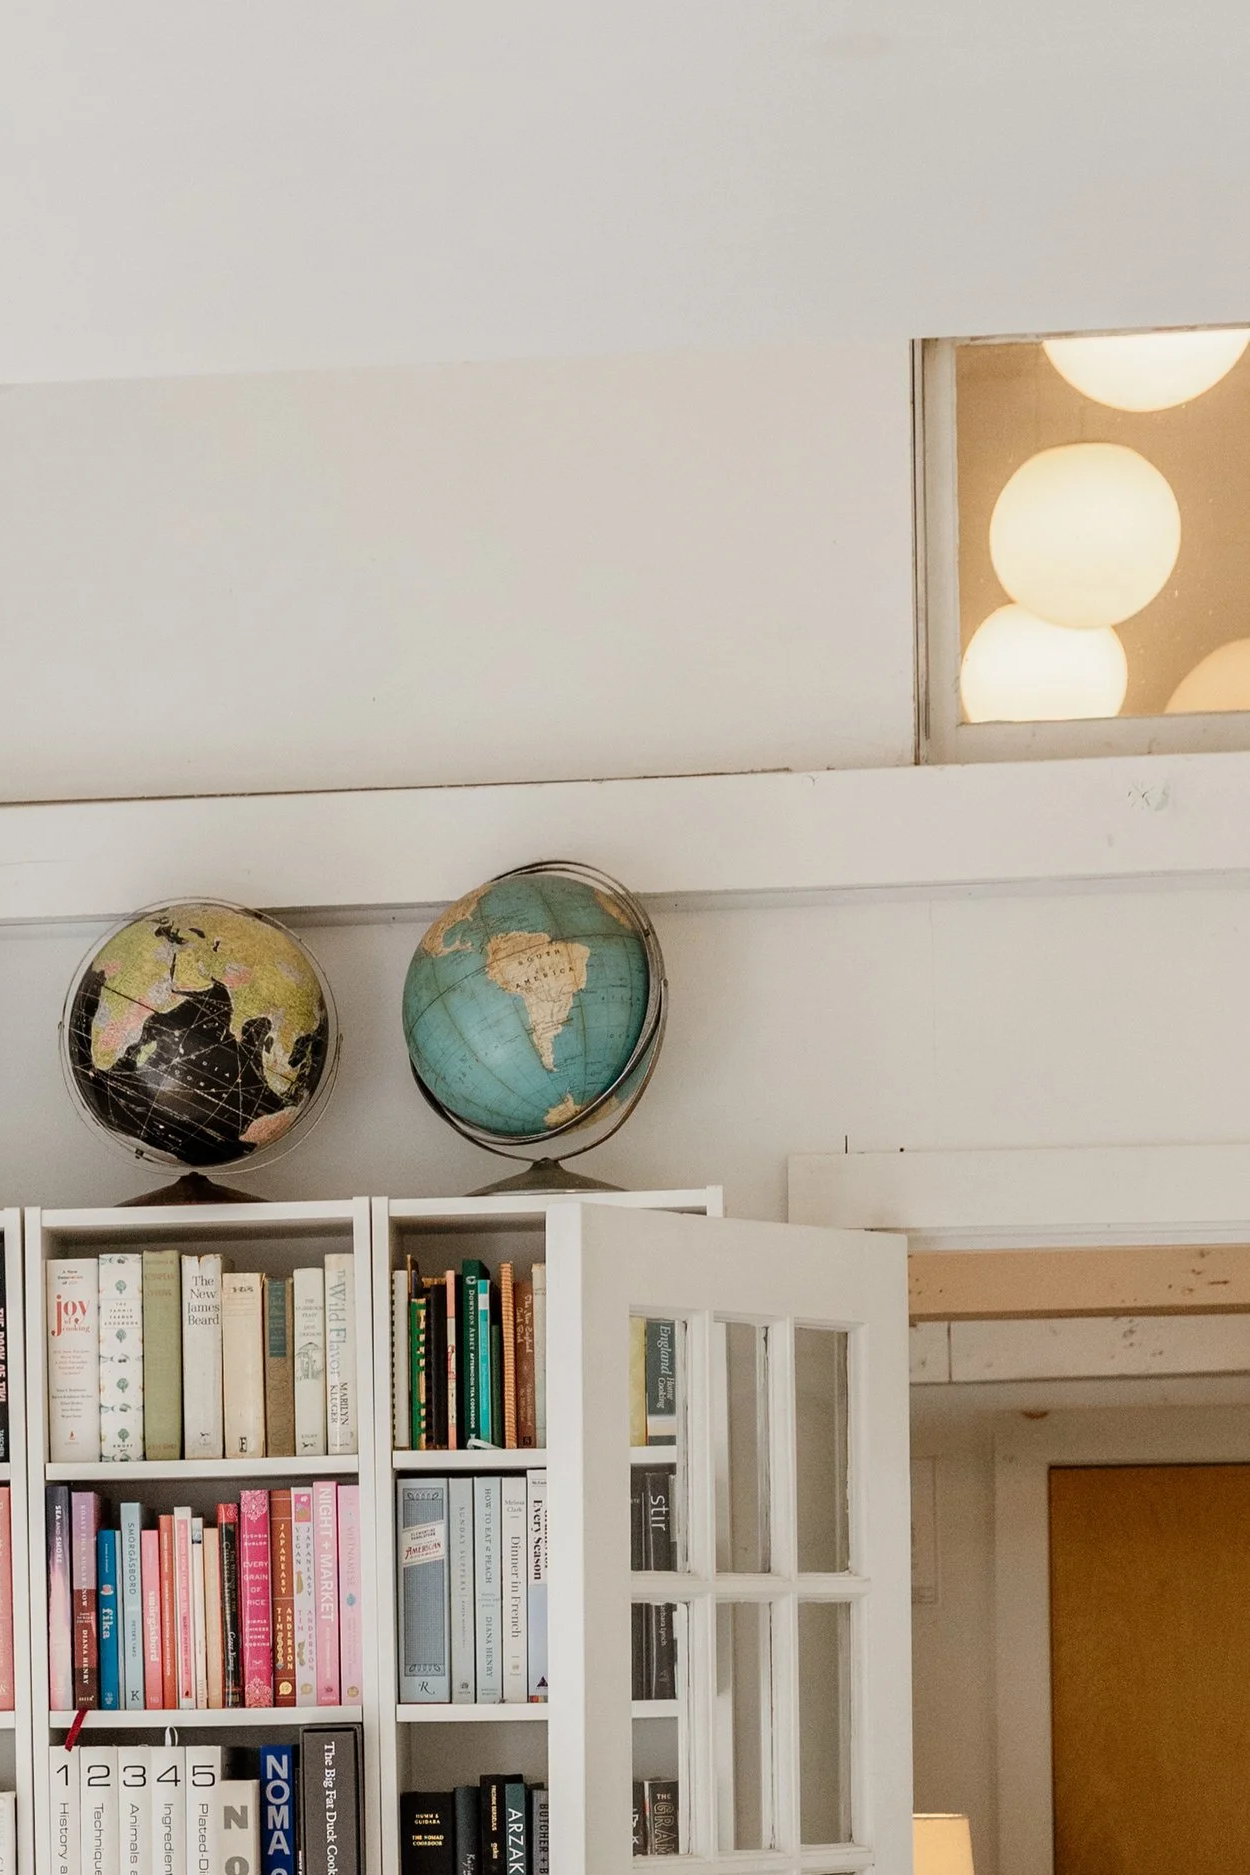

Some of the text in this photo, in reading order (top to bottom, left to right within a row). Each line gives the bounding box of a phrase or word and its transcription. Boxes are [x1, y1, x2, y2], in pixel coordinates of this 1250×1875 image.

[190, 1289, 217, 1299] New
[191, 1277, 215, 1287] The
[188, 1303, 220, 1313] James
[188, 1314, 220, 1326] Beard
[657, 1325, 673, 1374] England
[330, 1385, 339, 1424] KLUGER
[340, 1382, 349, 1425] MARILYN
[656, 1377, 667, 1408] Cooking
[667, 1378, 675, 1400] Home
[650, 1495, 668, 1531] stir
[531, 1500, 543, 1581] Every Season
[510, 1536, 522, 1639] Dinner in French
[102, 1608, 115, 1639] fika
[324, 1741, 337, 1767] The
[87, 1764, 111, 1787] 2
[122, 1764, 147, 1787] 3
[156, 1764, 181, 1787] 4
[191, 1764, 216, 1787] 5
[323, 1768, 337, 1788] Big
[266, 1754, 291, 1856] NOMA
[325, 1790, 338, 1809] Fat
[58, 1802, 73, 1860] History
[129, 1802, 141, 1864] Animals
[326, 1811, 339, 1844] Duck
[538, 1803, 550, 1854] BUTCHER
